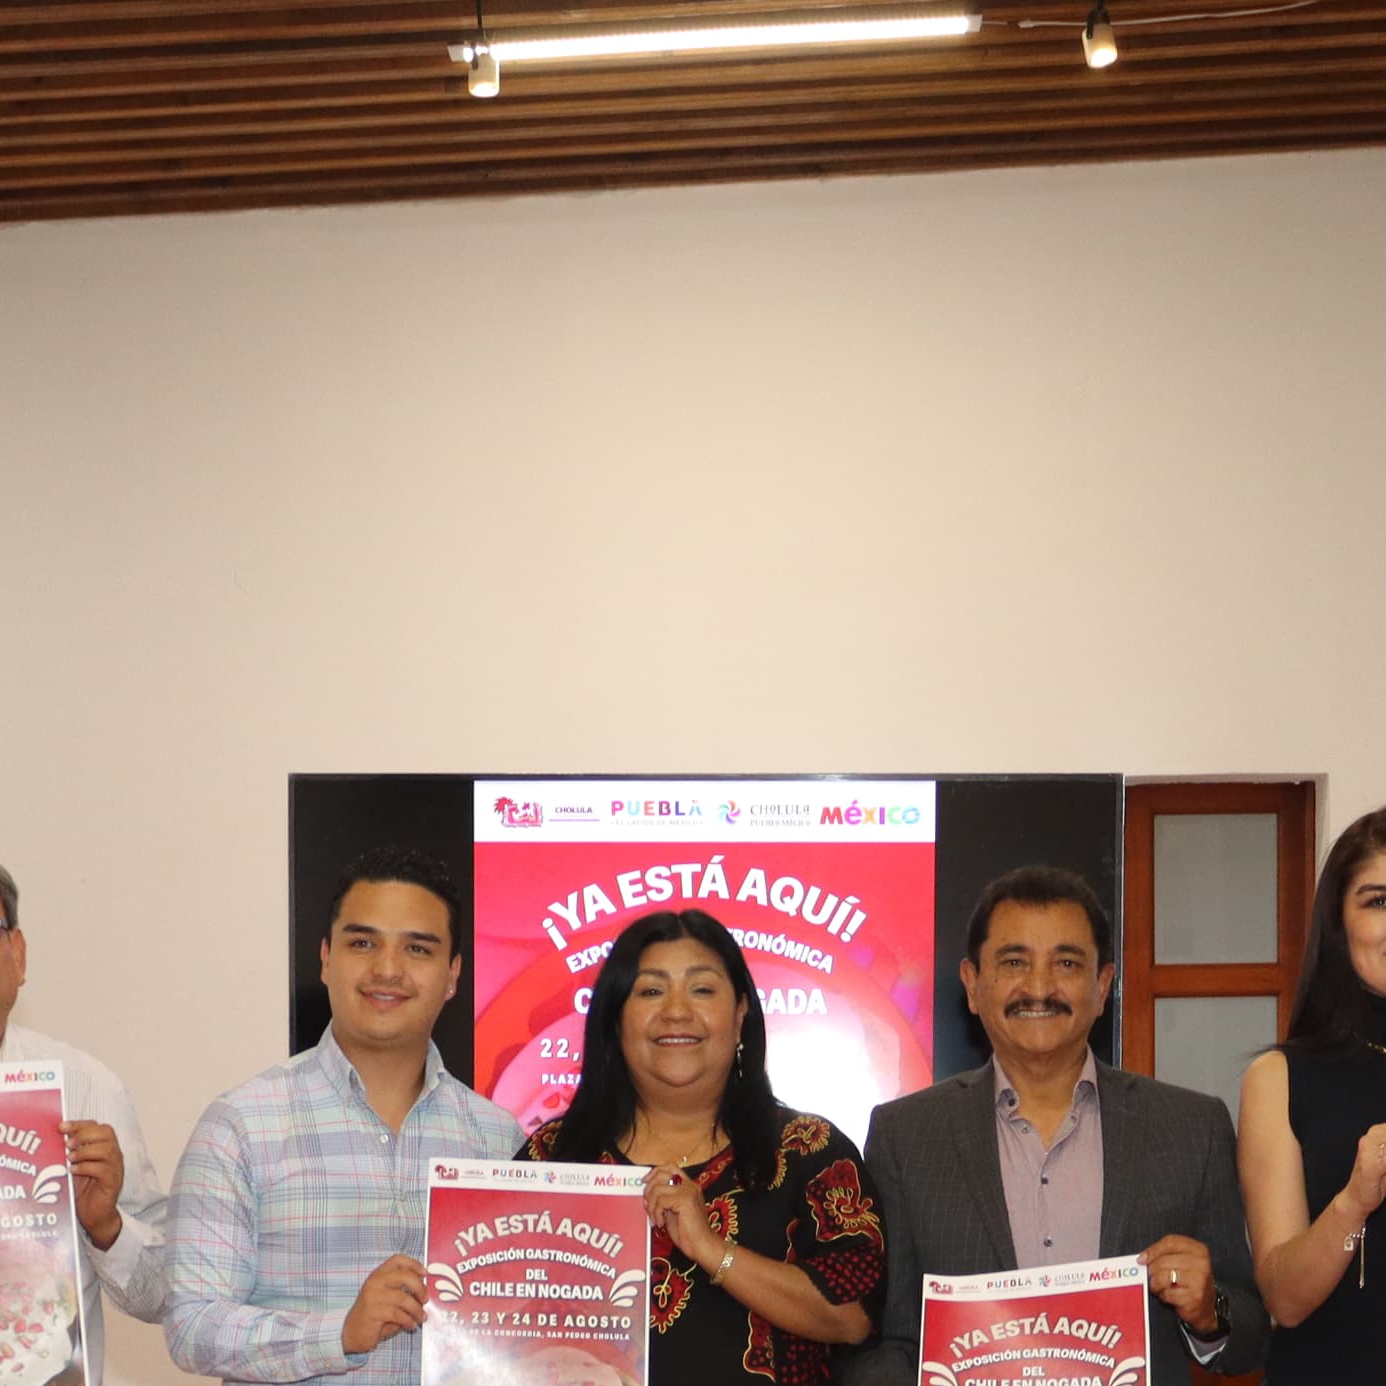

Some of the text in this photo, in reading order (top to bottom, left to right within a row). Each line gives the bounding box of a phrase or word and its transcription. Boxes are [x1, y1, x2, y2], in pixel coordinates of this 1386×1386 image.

[555, 806, 592, 814] CHOLULA
[611, 799, 702, 816] PUEBLA
[542, 855, 867, 950] ¡YA ESTÁ AQUÍ!
[540, 1038, 580, 1061] 22,
[454, 1211, 624, 1258] ¡YA ESTÁ AQUÍ!
[456, 1248, 616, 1278] EXPOSICIÓN GASTRONÓMICA
[526, 1269, 548, 1280] DEL
[469, 1282, 603, 1300] CHILE EN NOGADA
[949, 1312, 1122, 1358] ¡YA ESTÁ AQUÍ!
[952, 1348, 1115, 1372] EXPOSICIÓN GASTRONÓMICA
[1023, 1366, 1045, 1376] DEL
